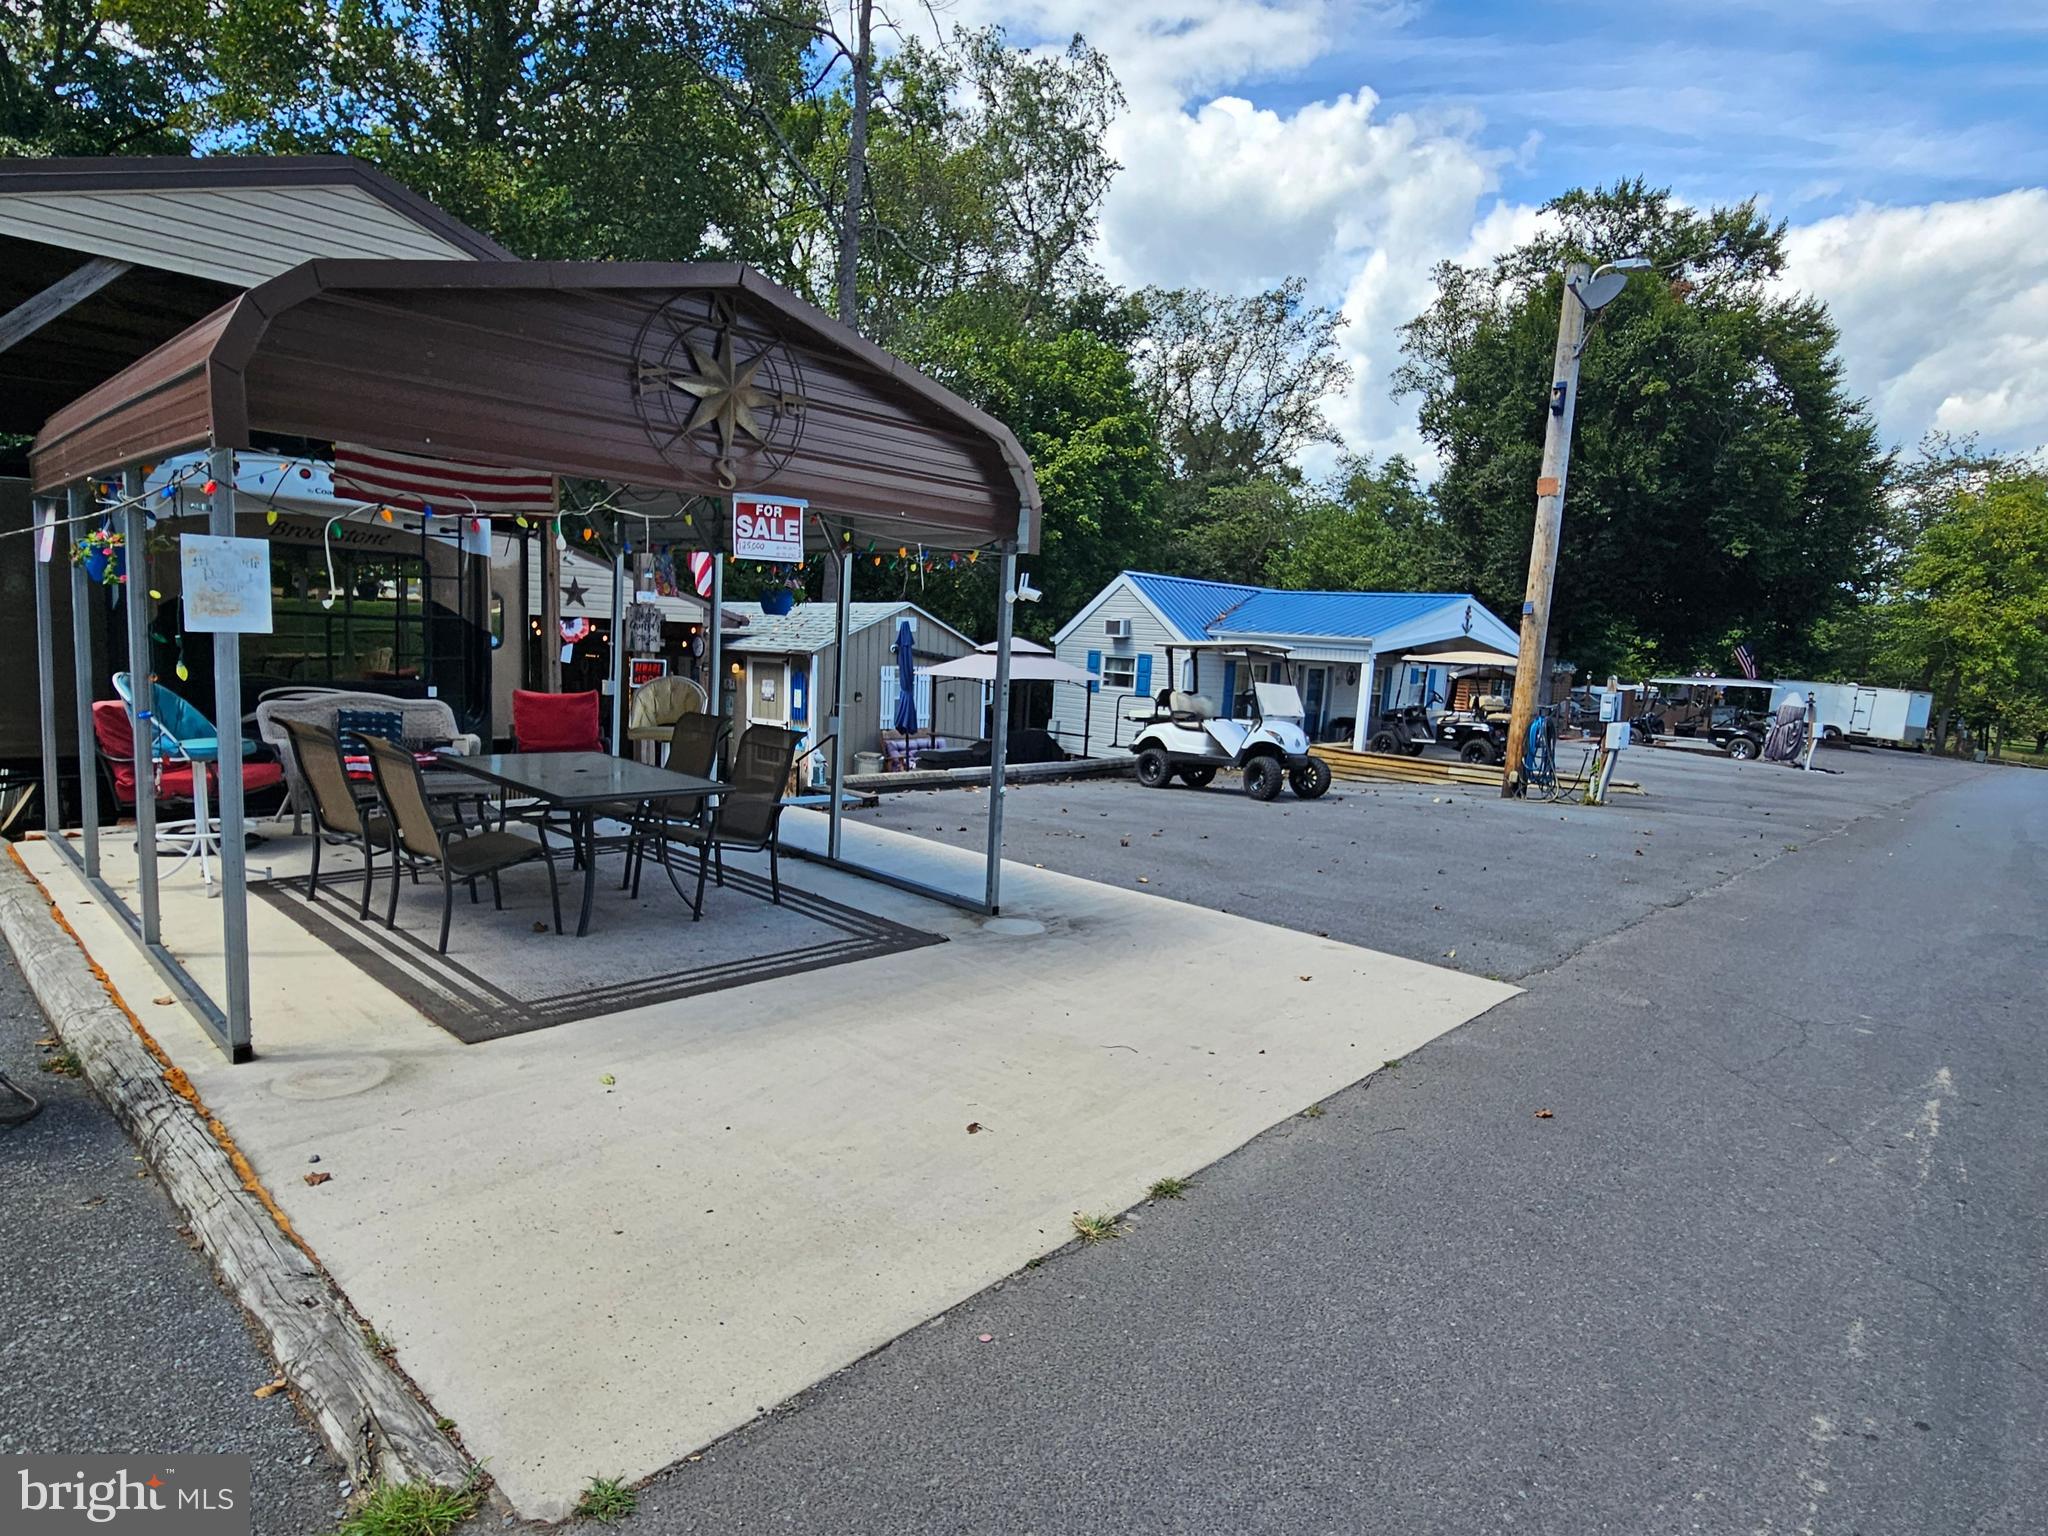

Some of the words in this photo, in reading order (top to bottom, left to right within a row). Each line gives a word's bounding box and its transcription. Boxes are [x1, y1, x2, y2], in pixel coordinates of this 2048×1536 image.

[755, 504, 783, 518] FOR
[269, 520, 393, 545] Broostone
[736, 514, 800, 542] SALE
